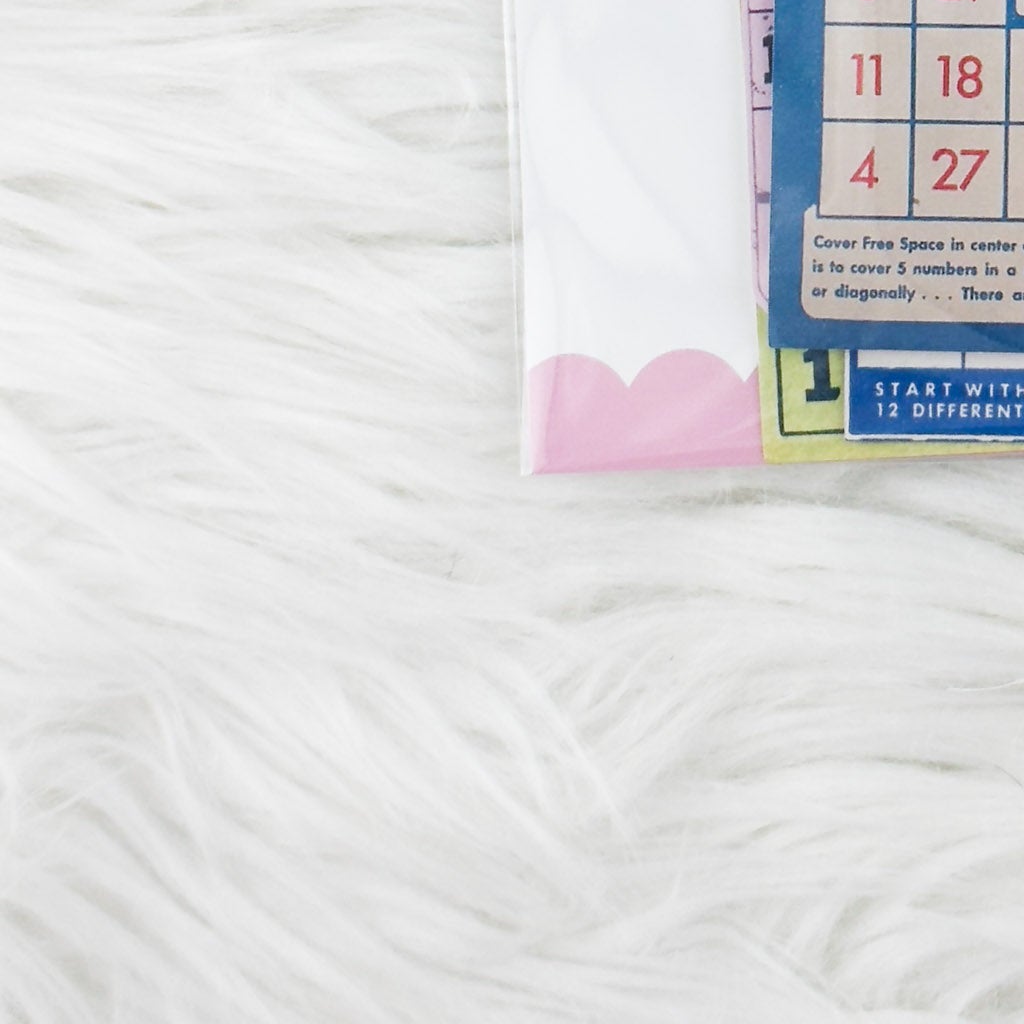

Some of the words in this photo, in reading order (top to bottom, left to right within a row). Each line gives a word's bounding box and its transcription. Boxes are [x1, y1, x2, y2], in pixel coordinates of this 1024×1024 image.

[850, 53, 882, 96] 11
[937, 55, 983, 100] 18
[849, 148, 879, 190] 4
[931, 148, 990, 192] 27
[813, 234, 858, 249] Cover
[862, 235, 894, 250] Free
[899, 236, 945, 253] Space
[950, 237, 965, 251] in
[970, 239, 1017, 252] center
[812, 258, 824, 273] is
[829, 260, 845, 273] to
[850, 263, 891, 275] cover
[896, 261, 907, 275] 5
[912, 260, 978, 276] numbers
[984, 261, 999, 276] in
[1006, 266, 1017, 276] a
[811, 286, 828, 298] or
[834, 283, 916, 303] diagonally
[960, 285, 1004, 301] There
[875, 382, 952, 396] START
[877, 402, 898, 417] 12
[912, 402, 1023, 419] DIFFERENT
